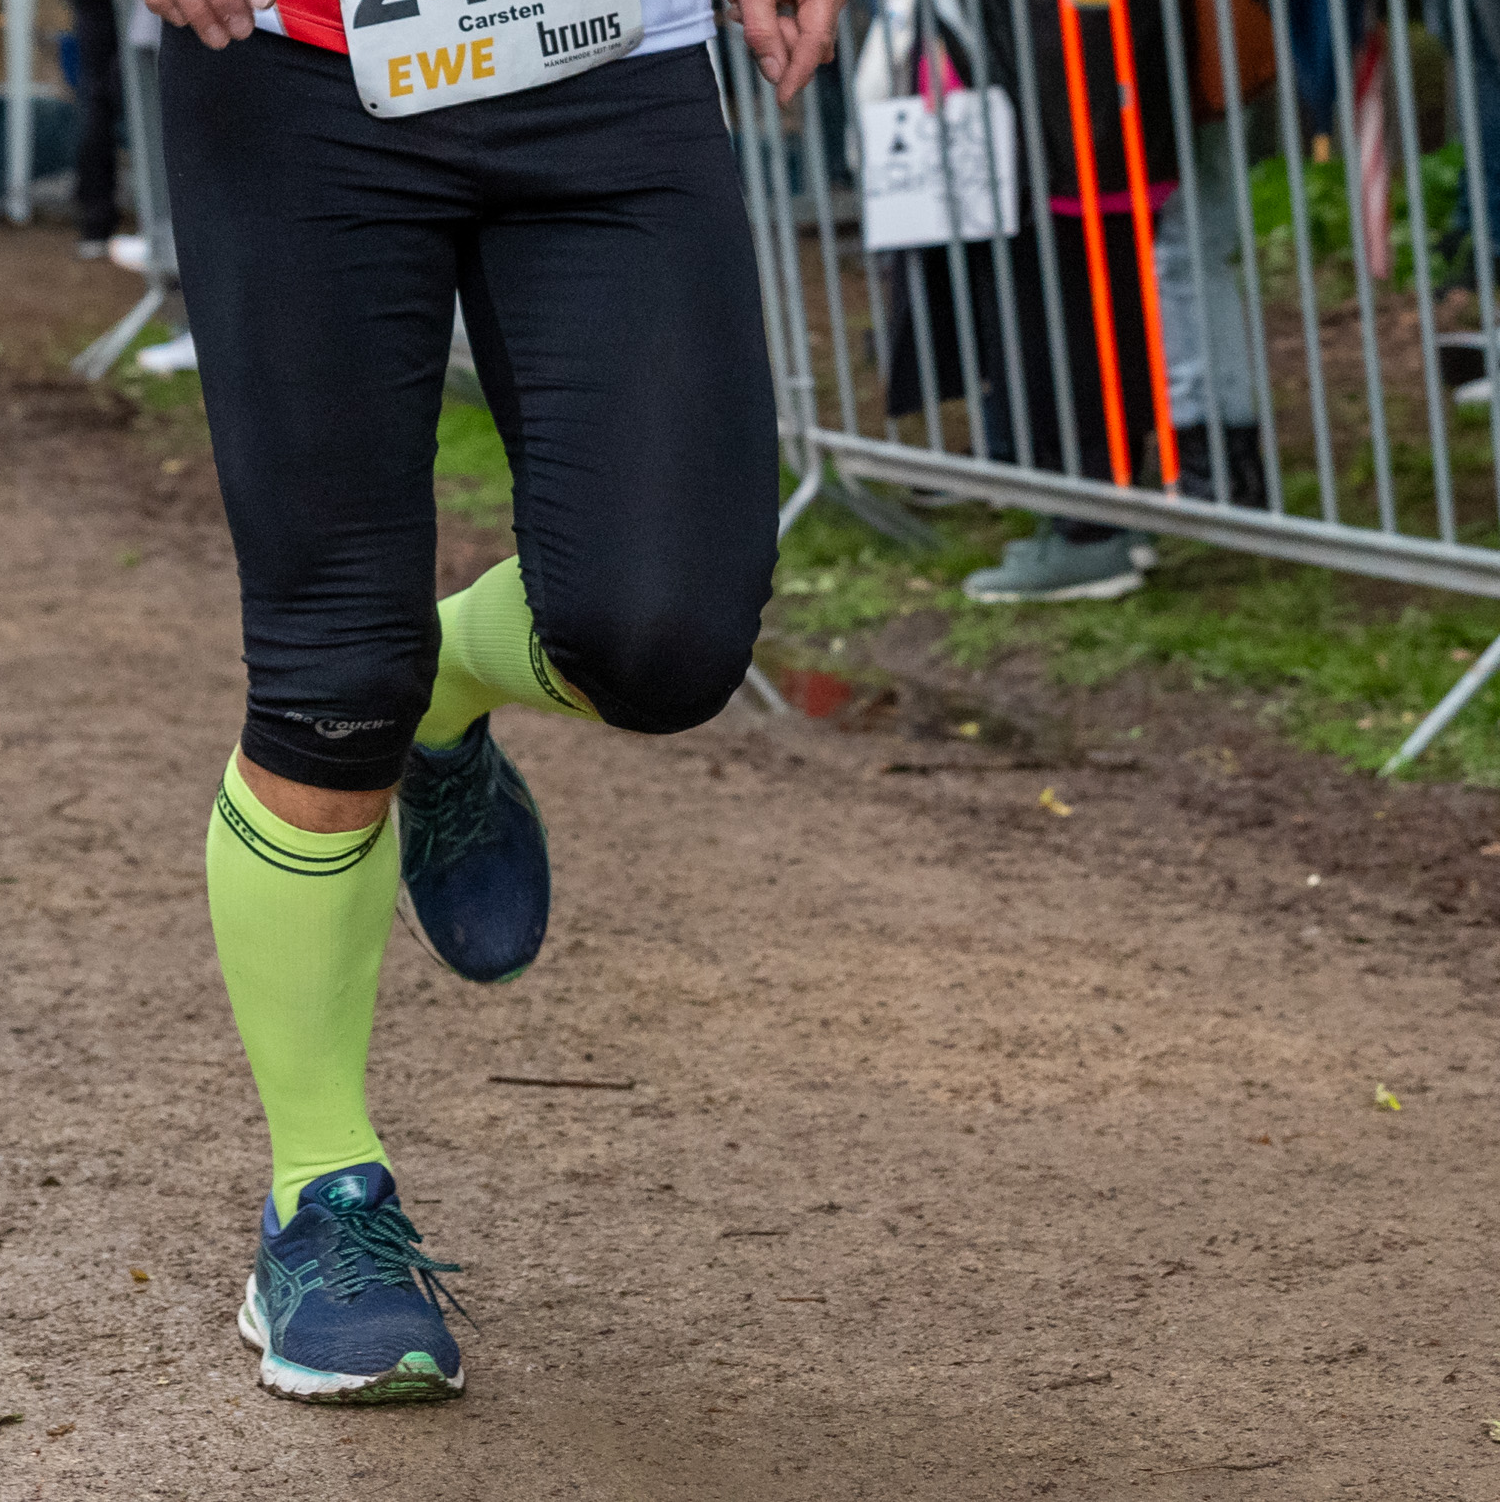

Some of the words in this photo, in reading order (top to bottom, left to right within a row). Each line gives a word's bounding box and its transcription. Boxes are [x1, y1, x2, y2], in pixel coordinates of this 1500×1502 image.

[458, 2, 545, 32] Carsten
[536, 13, 621, 57] bruns
[387, 37, 496, 98] EWE
